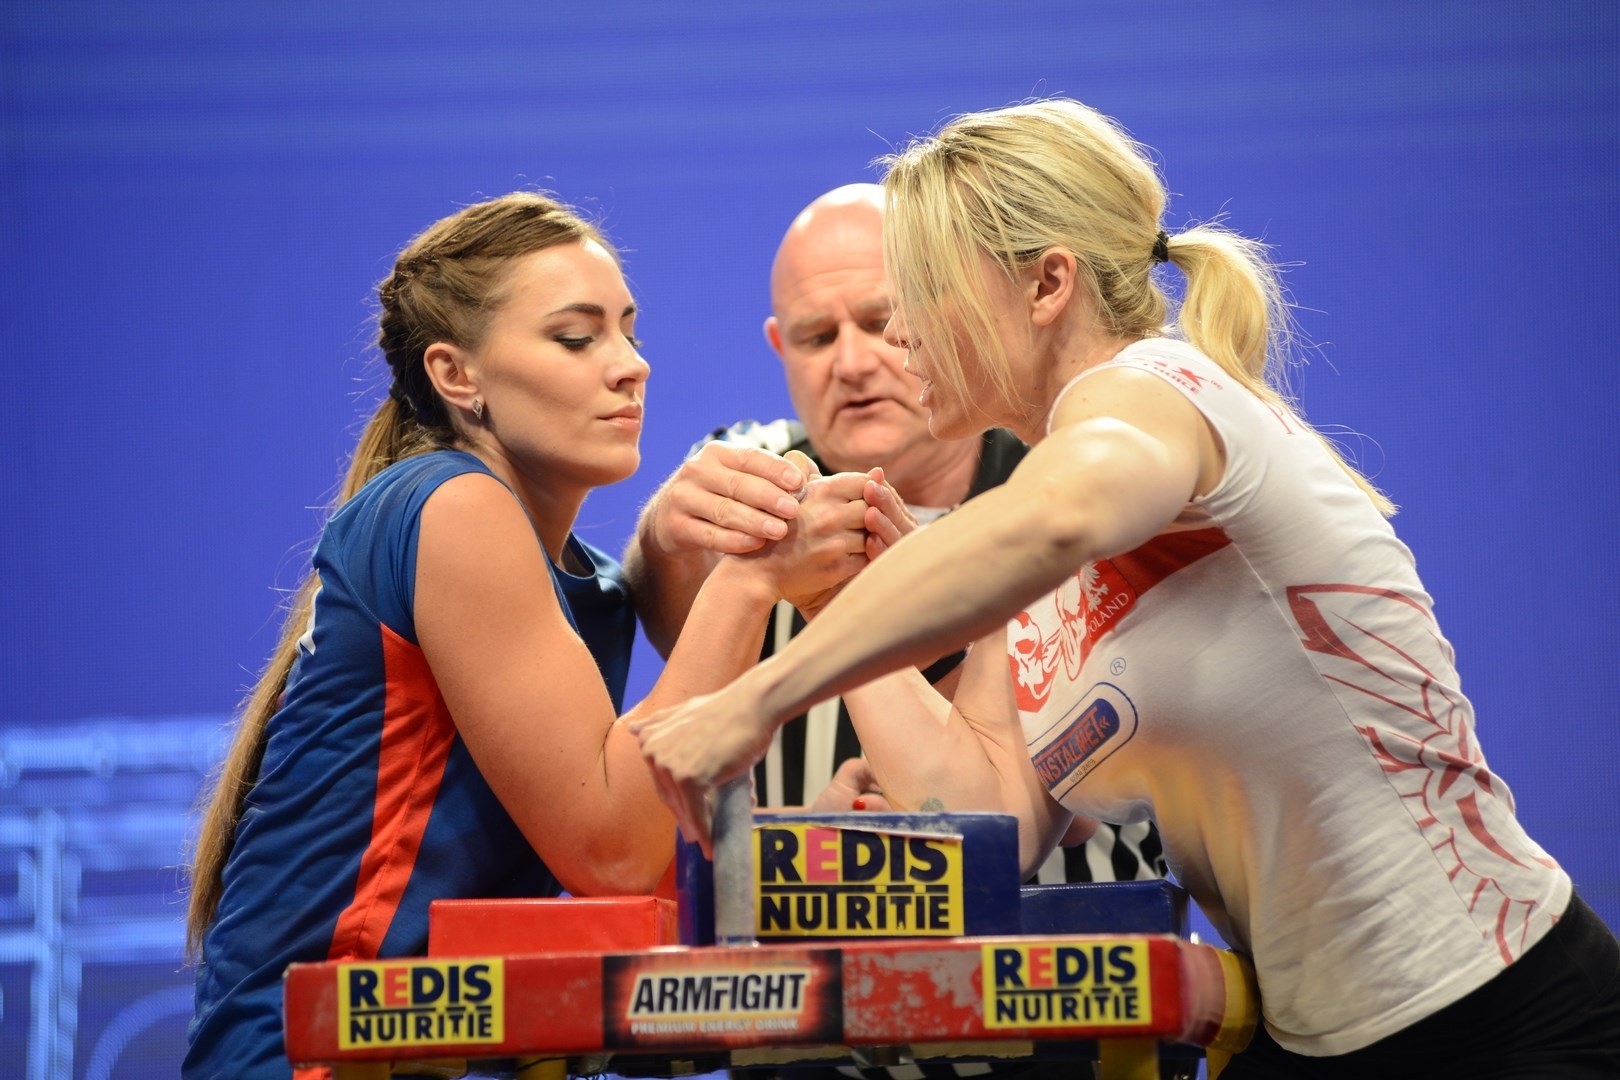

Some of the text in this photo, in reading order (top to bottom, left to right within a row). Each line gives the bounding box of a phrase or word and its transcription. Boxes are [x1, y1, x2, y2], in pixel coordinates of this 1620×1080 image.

[759, 828, 949, 883] REDIS
[760, 890, 950, 931] NUTRITIE
[349, 964, 492, 1008] REDIS
[994, 945, 1137, 987] REDIS
[633, 973, 806, 1014] ARMFIGHT
[995, 992, 1139, 1022] NUTRITIE
[349, 1012, 492, 1043] NUTRITIE
[631, 1019, 799, 1034] PREMIUM ENERGY DRINK
